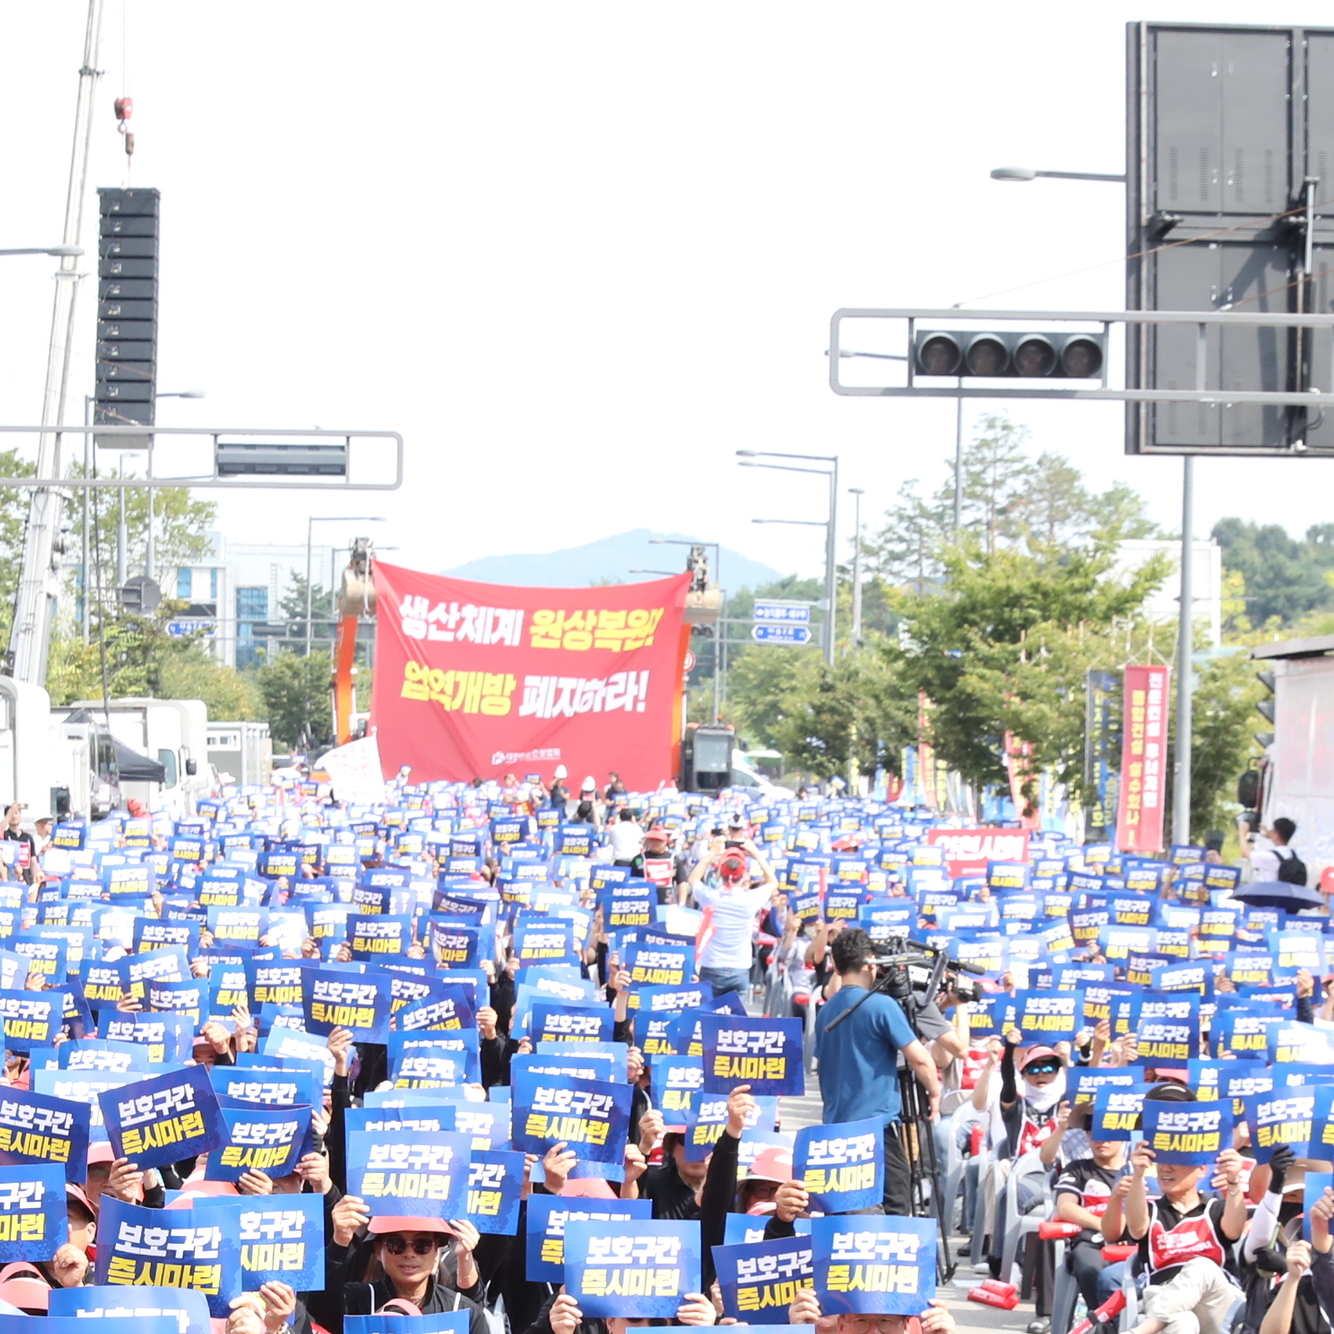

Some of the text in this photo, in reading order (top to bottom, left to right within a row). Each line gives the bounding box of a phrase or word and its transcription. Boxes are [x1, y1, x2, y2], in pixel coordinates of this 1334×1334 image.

[399, 595, 665, 652] 생산체계 원상복원!
[519, 670, 650, 719] 폐지하라!
[935, 835, 1025, 861] 인천시회
[111, 868, 148, 885] 보호구간
[633, 951, 685, 970] 보호구간
[313, 981, 377, 1008] 보호구간
[312, 1003, 374, 1027] 즉시마련
[119, 1084, 194, 1127] 보호구간
[532, 1087, 613, 1117] 보호구간
[123, 1112, 204, 1154] 즉시마련
[526, 1115, 609, 1144] 즉시마련
[1157, 1111, 1221, 1131] 보호구간
[1154, 1133, 1220, 1151] 즉시마련
[367, 1144, 453, 1171] 보호구간
[362, 1171, 451, 1199] 즉시마련
[832, 1231, 923, 1261] 보호구간
[826, 1265, 919, 1294] 즉시마련
